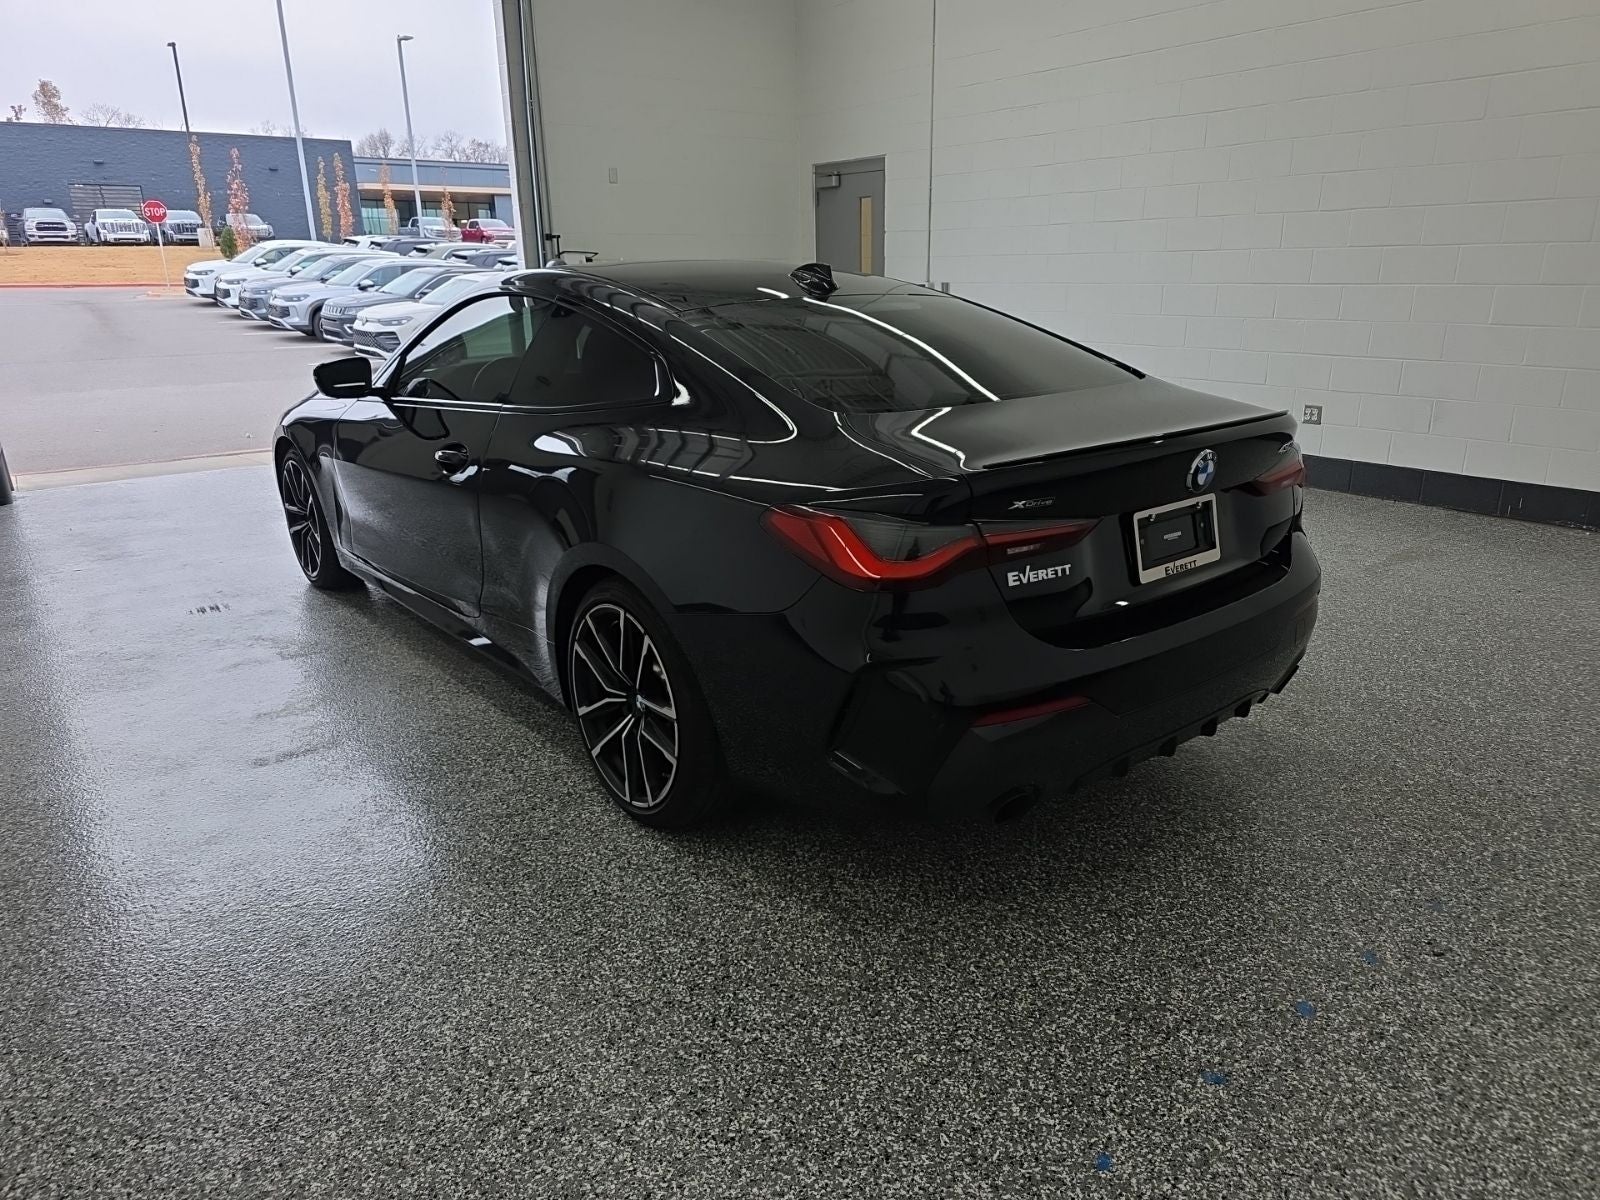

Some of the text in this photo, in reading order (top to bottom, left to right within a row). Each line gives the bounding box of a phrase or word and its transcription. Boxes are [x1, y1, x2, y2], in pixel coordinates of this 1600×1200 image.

[145, 207, 165, 217] STOP
[1165, 560, 1197, 575] EVERETT
[1007, 564, 1071, 587] EVERETT
